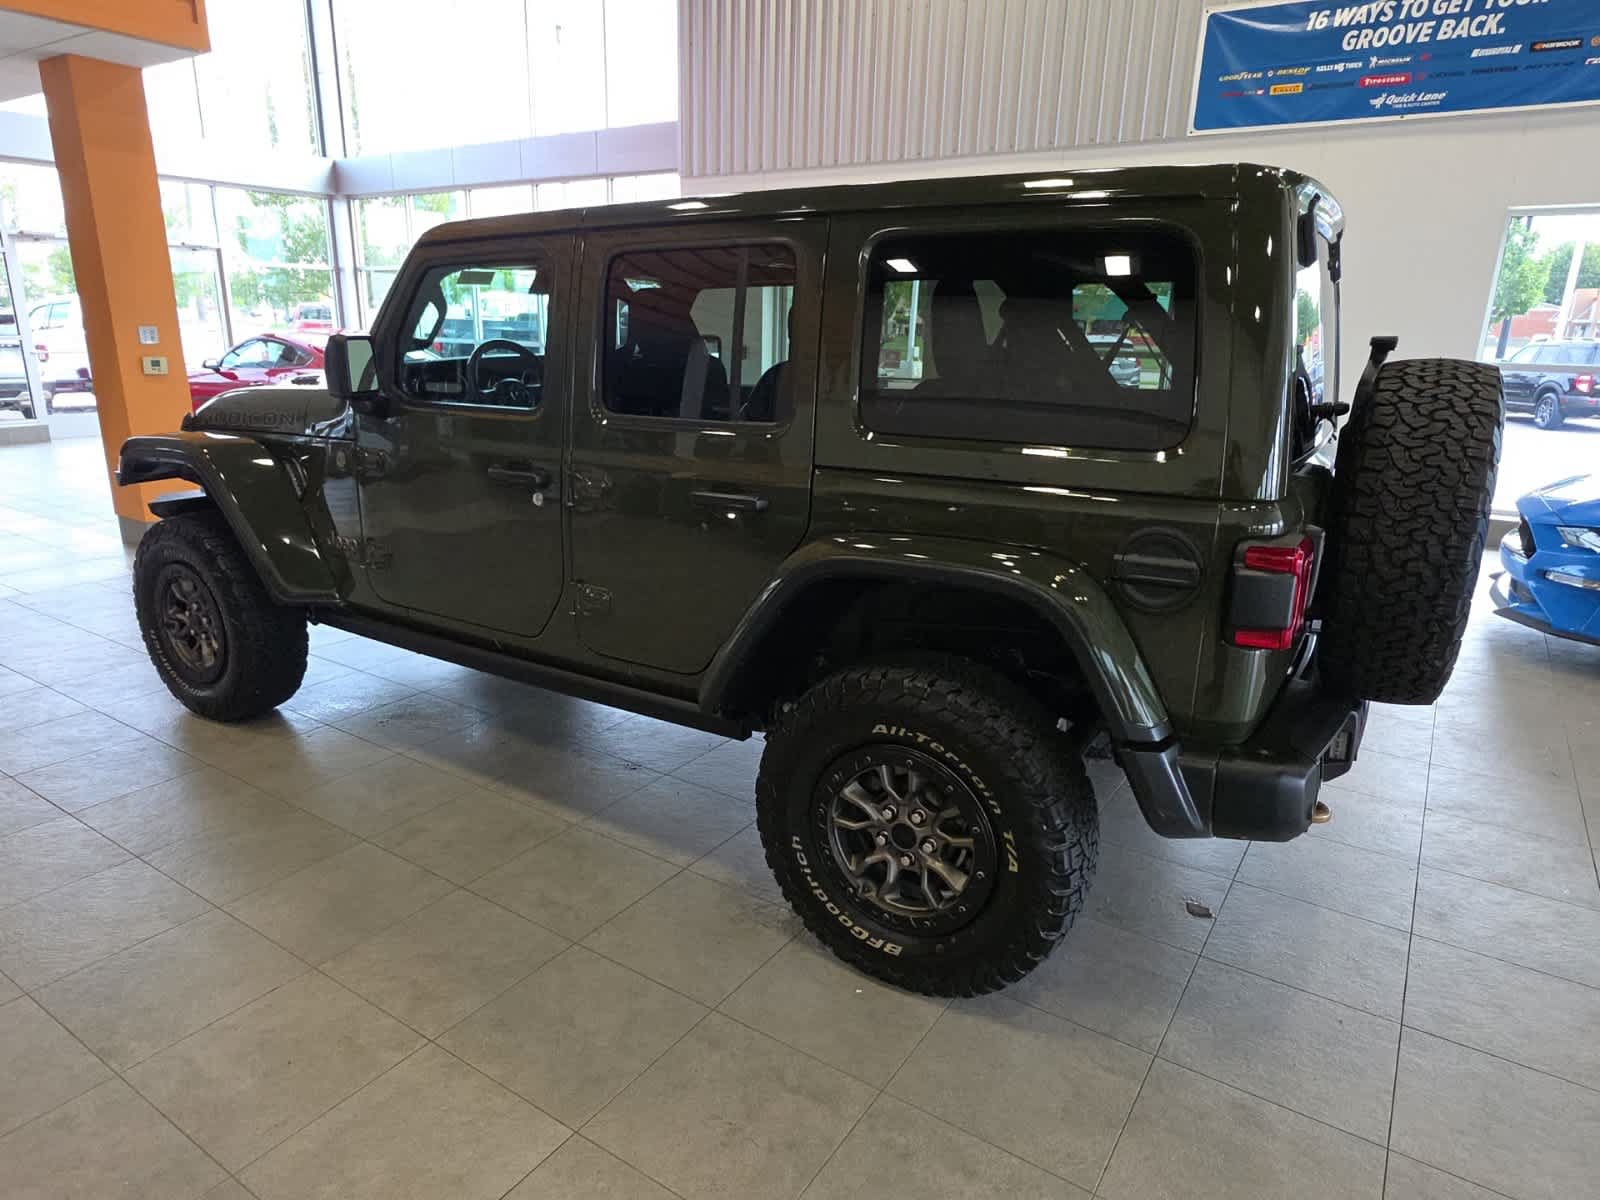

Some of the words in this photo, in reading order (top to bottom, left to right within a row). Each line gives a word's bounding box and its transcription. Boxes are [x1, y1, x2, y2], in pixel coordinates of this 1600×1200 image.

[1306, 10, 1331, 31] 16
[1333, 1, 1397, 27] WAYS
[1399, 0, 1429, 19] TO
[1342, 21, 1436, 51] GROOVE
[1436, 13, 1506, 41] BACK.
[1385, 93, 1417, 105] Quick
[1418, 92, 1447, 102] Lane
[872, 724, 1001, 815] All-Terrain
[1003, 830, 1019, 873] T/A
[791, 835, 903, 957] BFGoodrich
